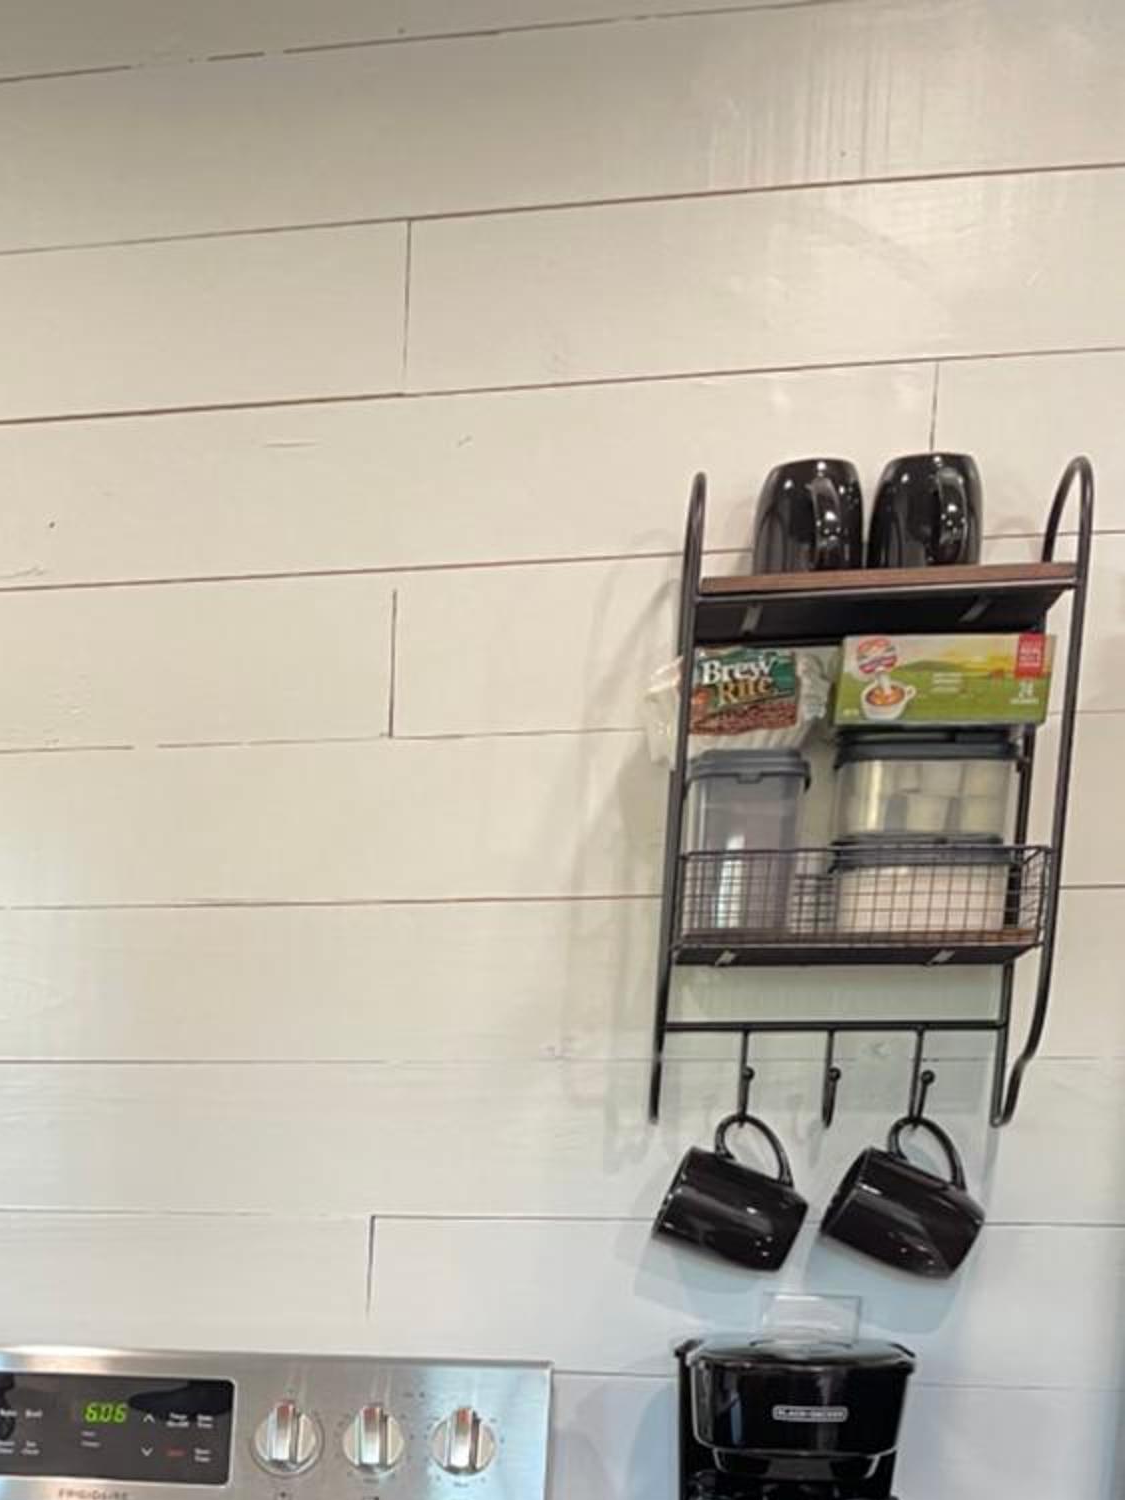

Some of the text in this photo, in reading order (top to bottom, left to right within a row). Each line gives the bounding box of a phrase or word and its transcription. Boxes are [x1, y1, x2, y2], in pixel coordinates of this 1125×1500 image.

[698, 655, 776, 684] Brew
[717, 676, 773, 705] Rite
[85, 1402, 127, 1422] 606
